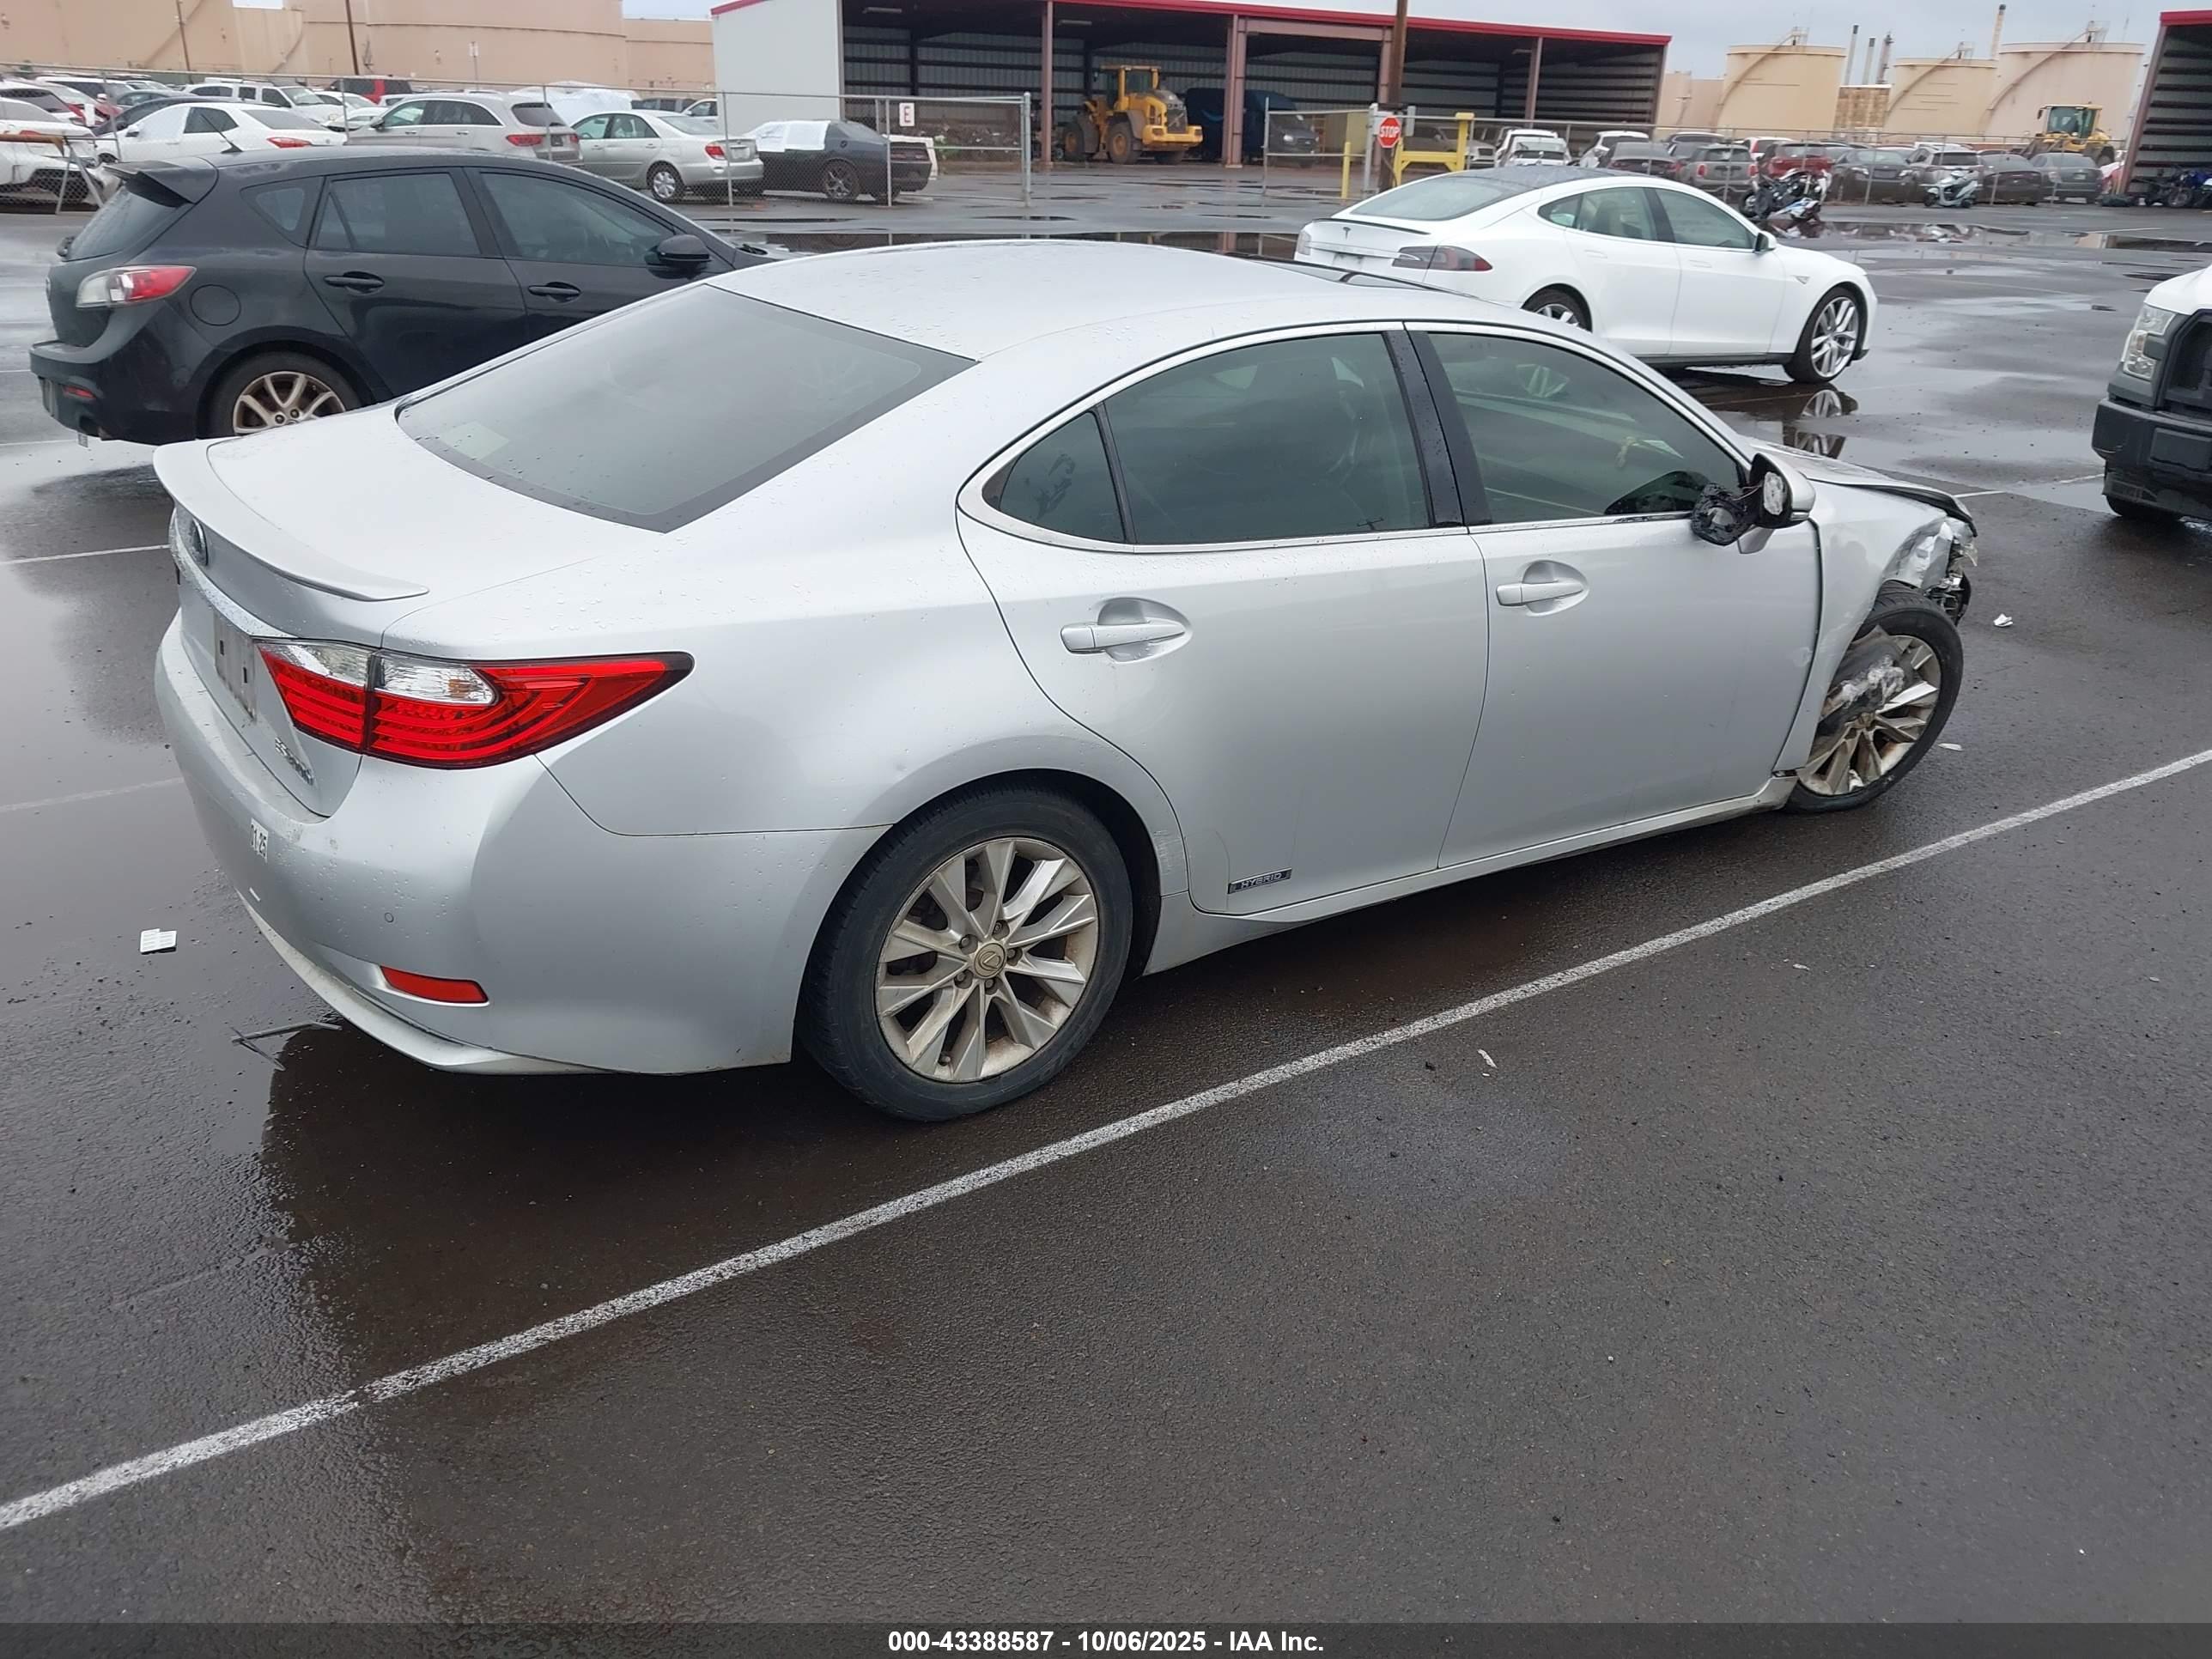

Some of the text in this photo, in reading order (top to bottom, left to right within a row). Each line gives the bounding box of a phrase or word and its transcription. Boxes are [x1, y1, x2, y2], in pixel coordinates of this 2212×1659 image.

[904, 106, 911, 123] E
[1381, 125, 1400, 137] STOP
[1241, 872, 1282, 889] HYBRID
